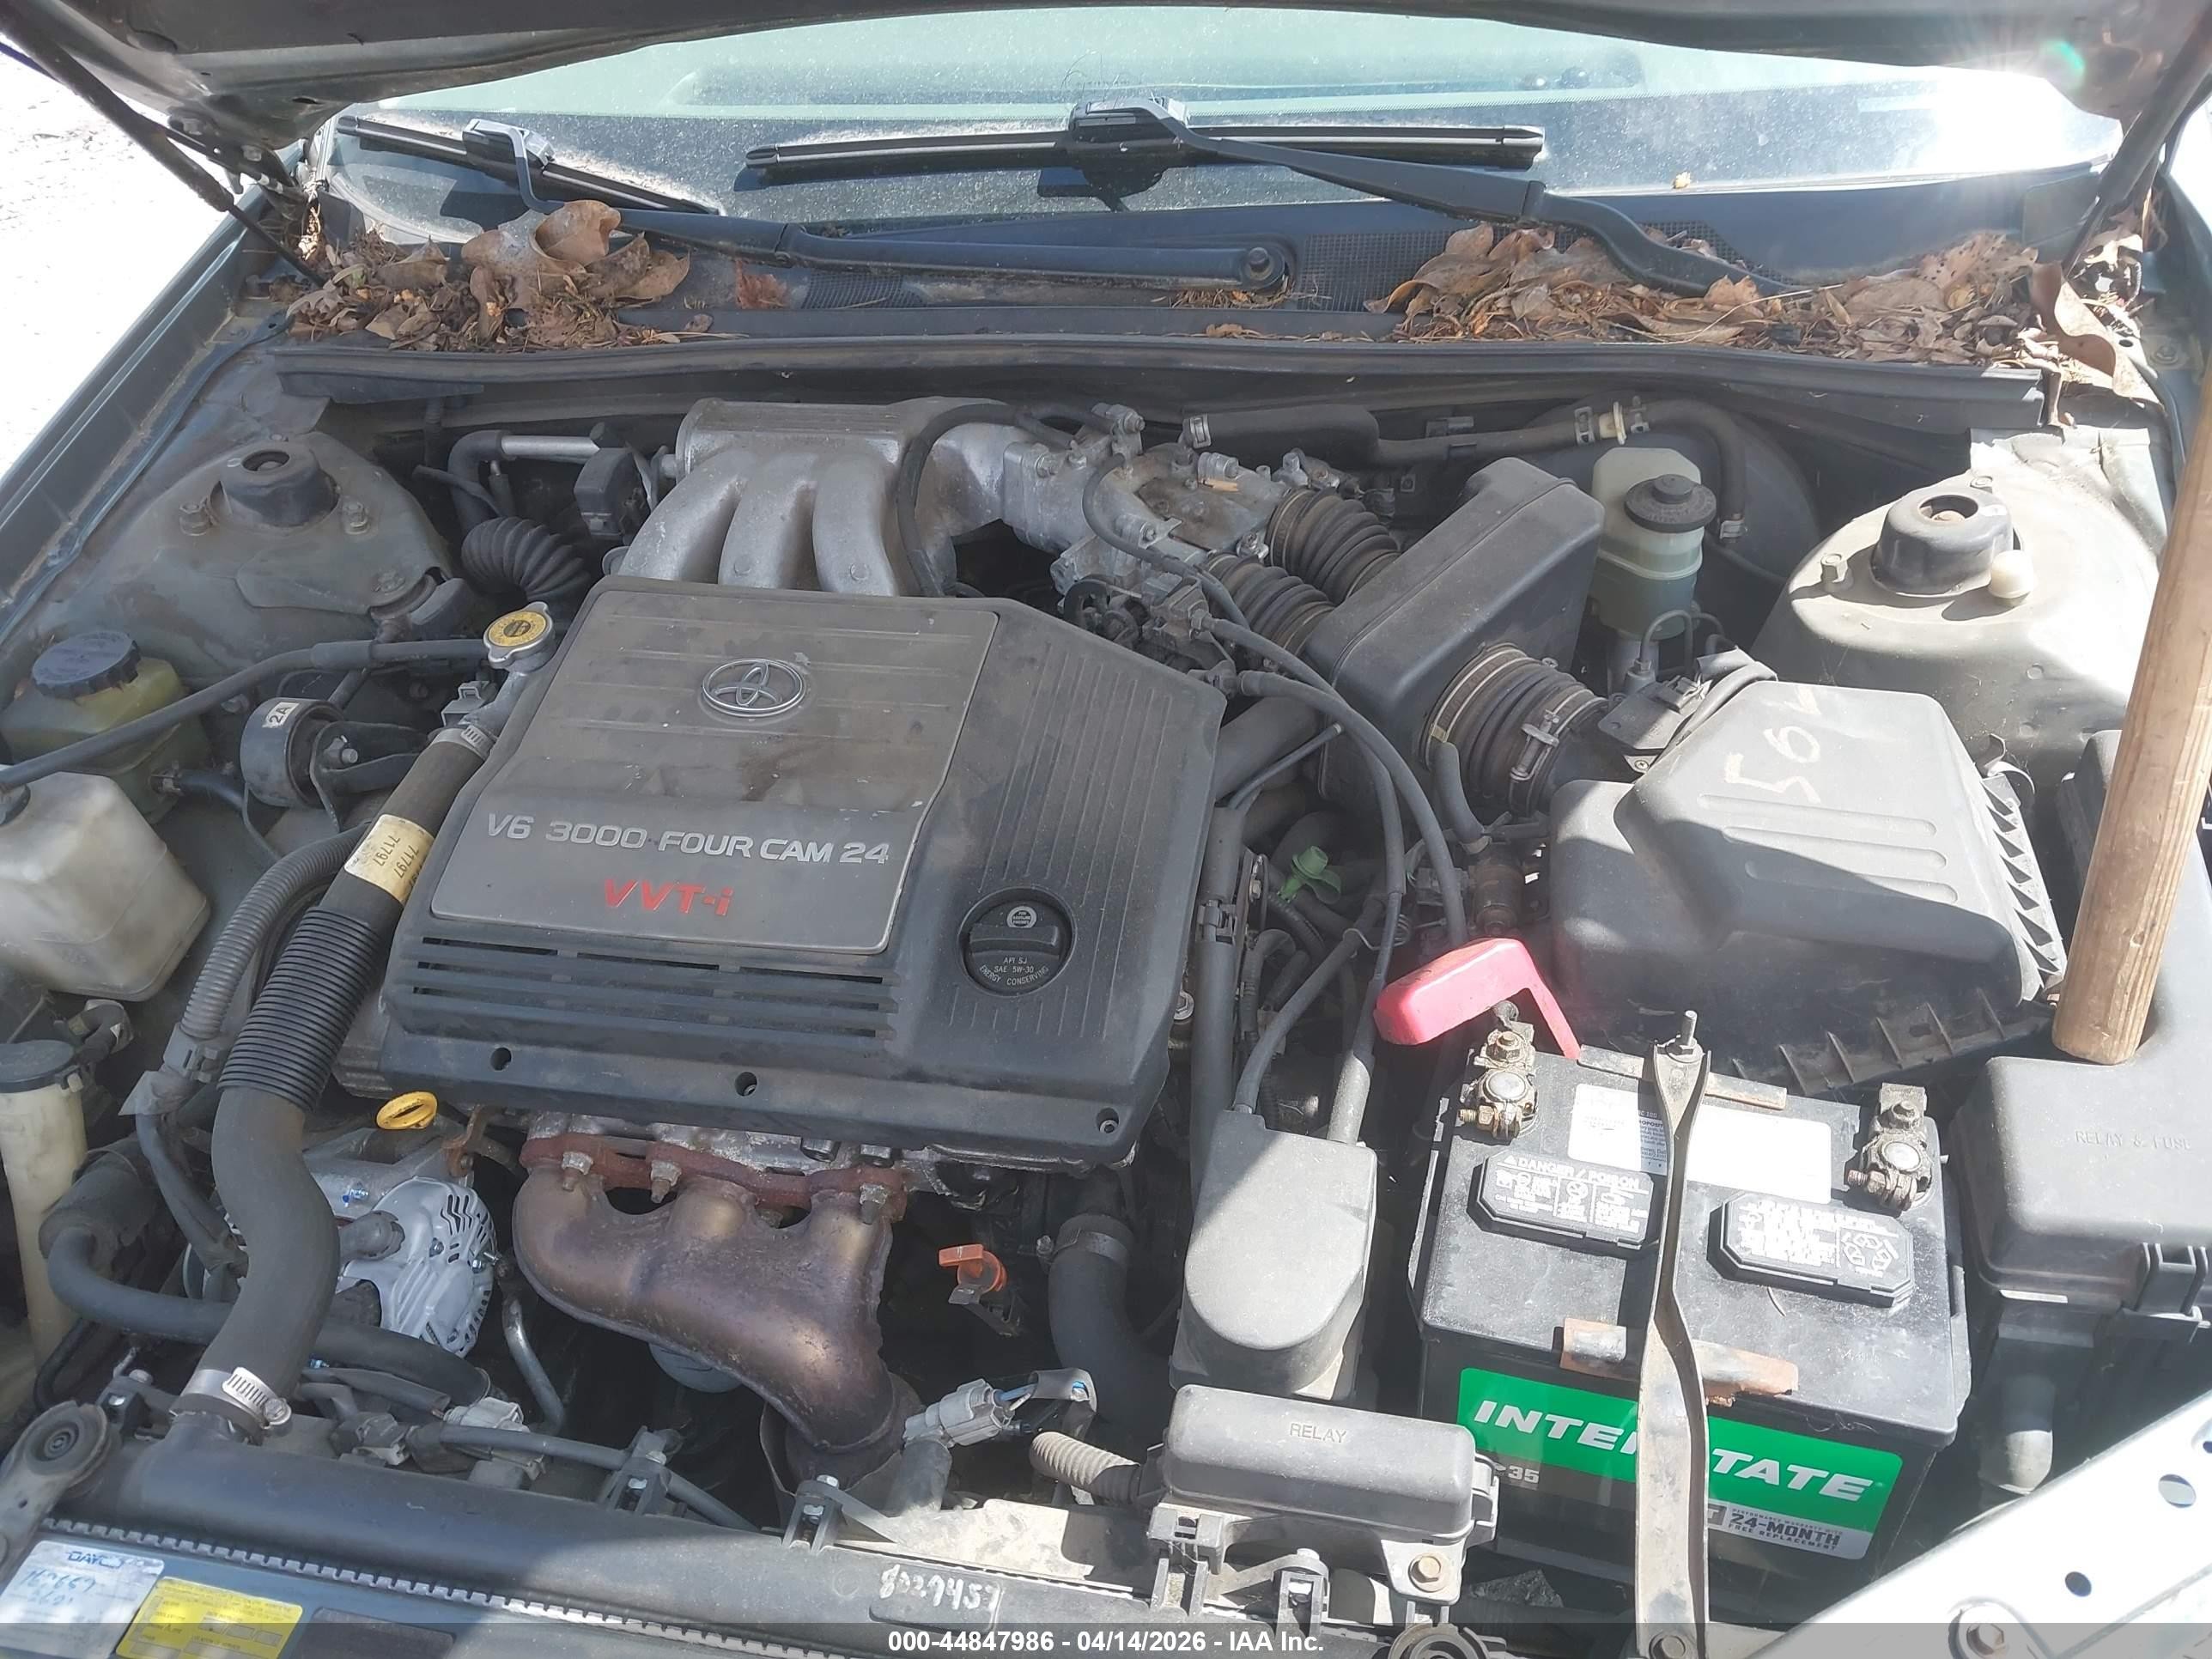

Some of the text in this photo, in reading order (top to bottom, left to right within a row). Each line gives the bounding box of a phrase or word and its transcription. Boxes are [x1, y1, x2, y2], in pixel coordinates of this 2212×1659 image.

[269, 707, 292, 724] 2A
[373, 835, 401, 866] 71797
[487, 812, 890, 866] V6 3000 FOUR CAM 24
[393, 844, 420, 879] 71797
[605, 878, 733, 917] VVT-i
[979, 964, 1049, 986] ENERGY CONSERVING
[2075, 1130, 2192, 1151] RELAY & FUSE
[1518, 1157, 1575, 1178] DANGER
[1588, 1170, 1640, 1190] POISON
[1289, 1422, 1347, 1443] RELAY
[1729, 1512, 1840, 1547] 24-MONTH
[1729, 1523, 1837, 1550] FREE REPLACEMENT
